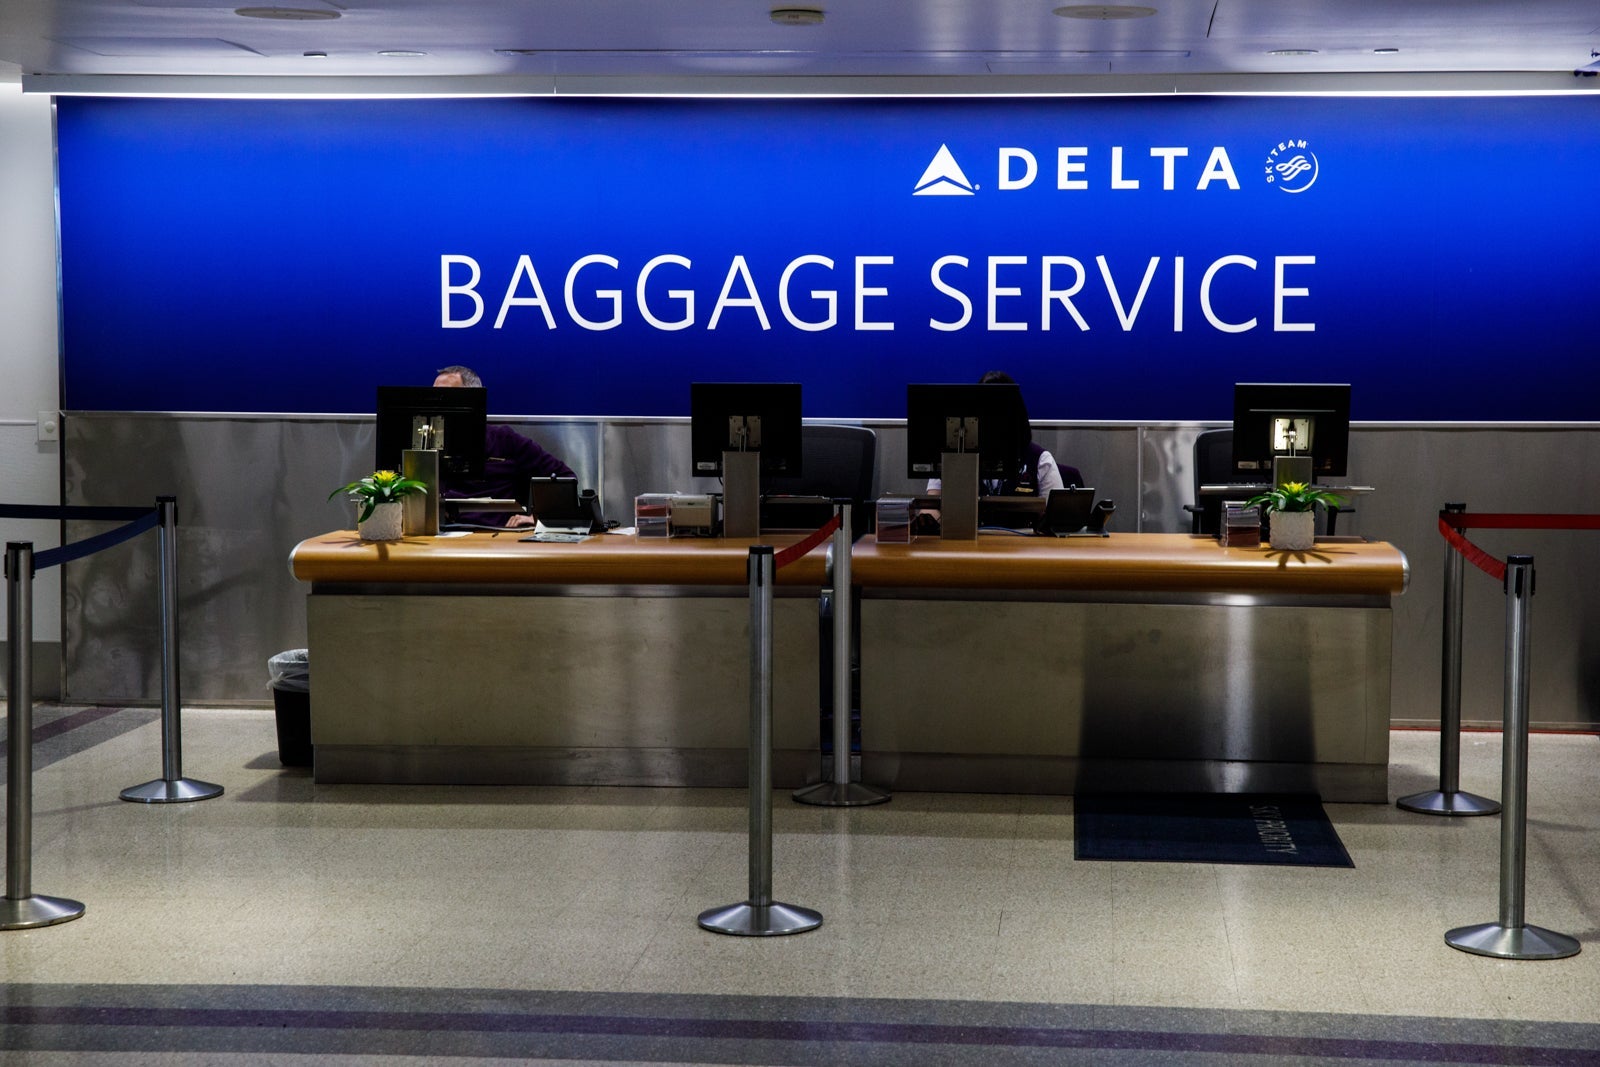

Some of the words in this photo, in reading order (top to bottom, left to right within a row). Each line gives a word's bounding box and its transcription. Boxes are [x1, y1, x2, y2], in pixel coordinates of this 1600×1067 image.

[998, 146, 1241, 191] DELTA
[1265, 139, 1307, 184] SKYTEAM
[441, 254, 895, 332] BAGGAGE
[929, 254, 1316, 333] SERVICE
